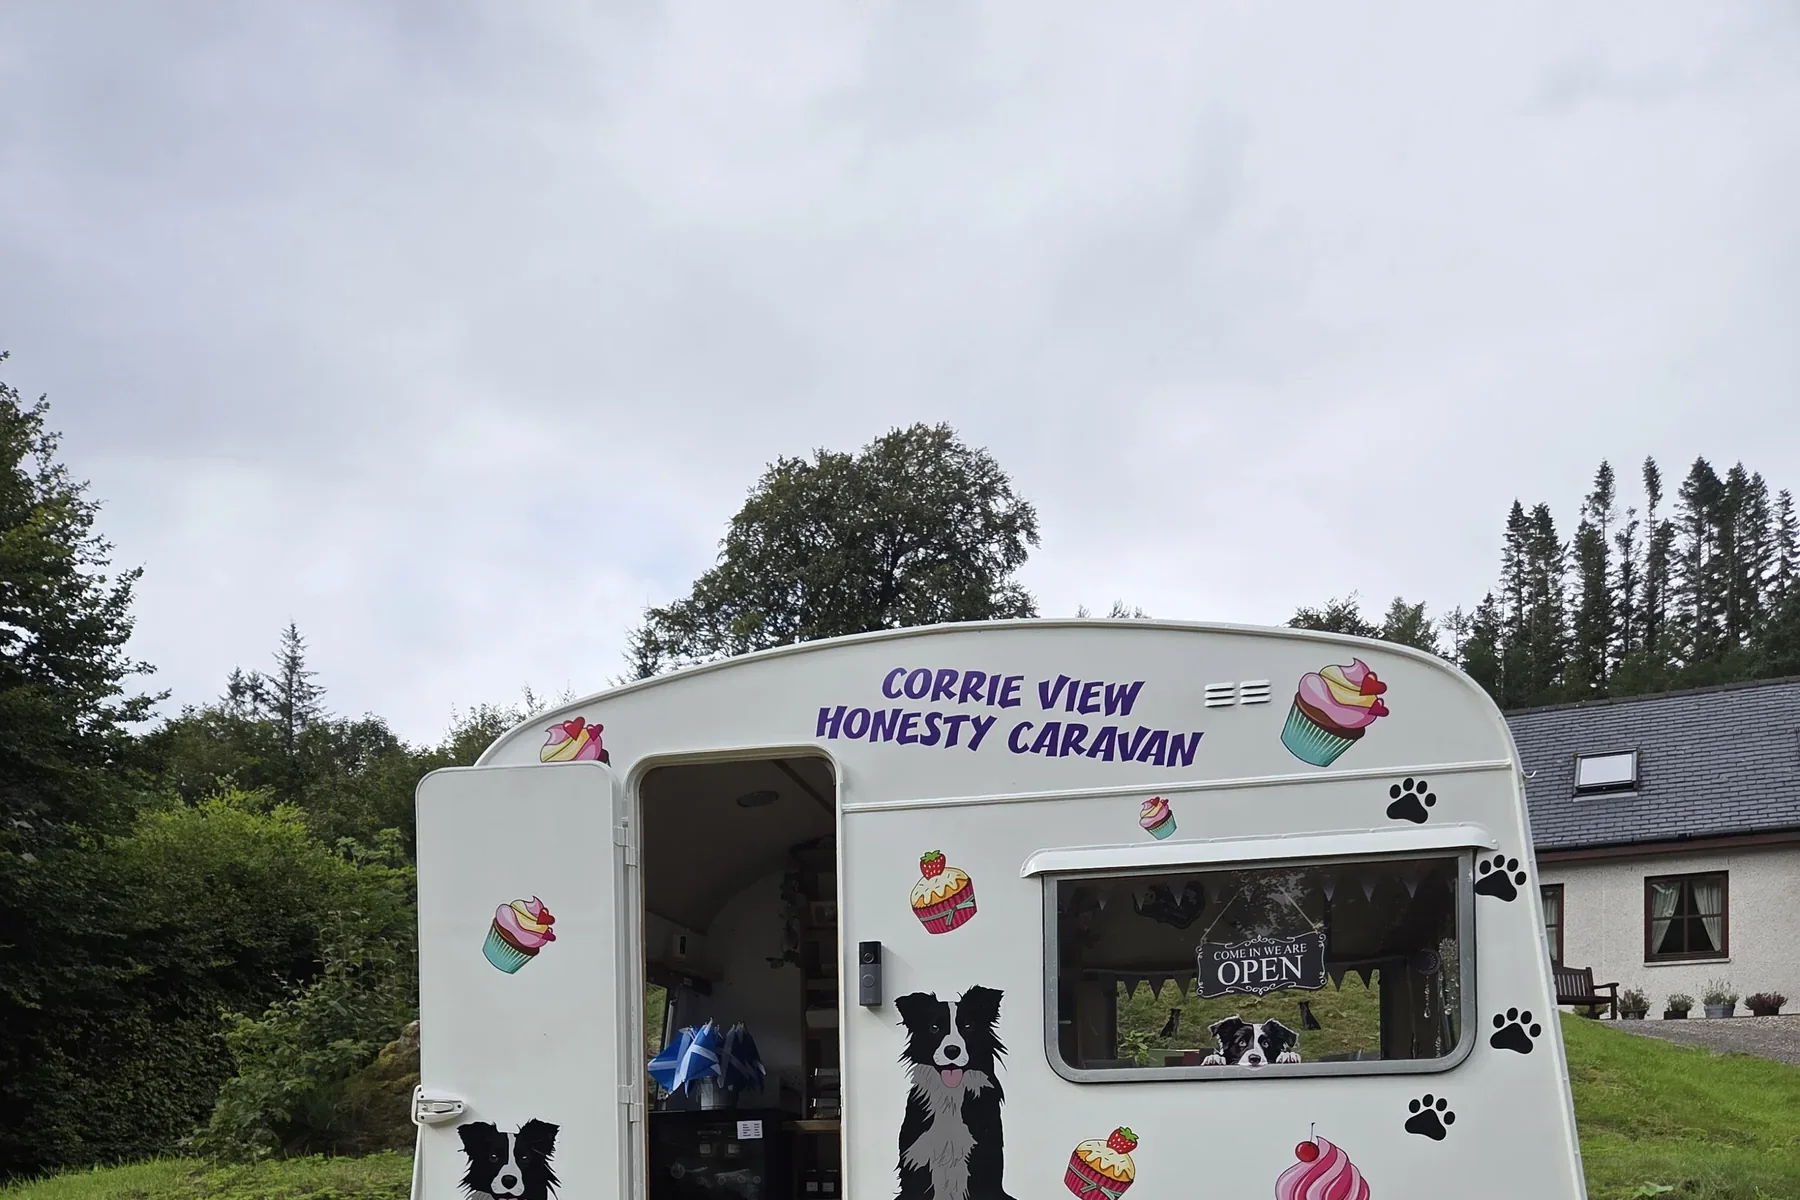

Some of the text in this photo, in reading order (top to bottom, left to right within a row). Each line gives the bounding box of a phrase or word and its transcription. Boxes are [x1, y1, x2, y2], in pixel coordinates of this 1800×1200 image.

[882, 667, 1146, 718] CORRIE VIEW
[816, 705, 1205, 768] HONESTY CARAVAN
[1213, 943, 1308, 961] COME IN WE ARE
[1217, 954, 1304, 986] OPEN
